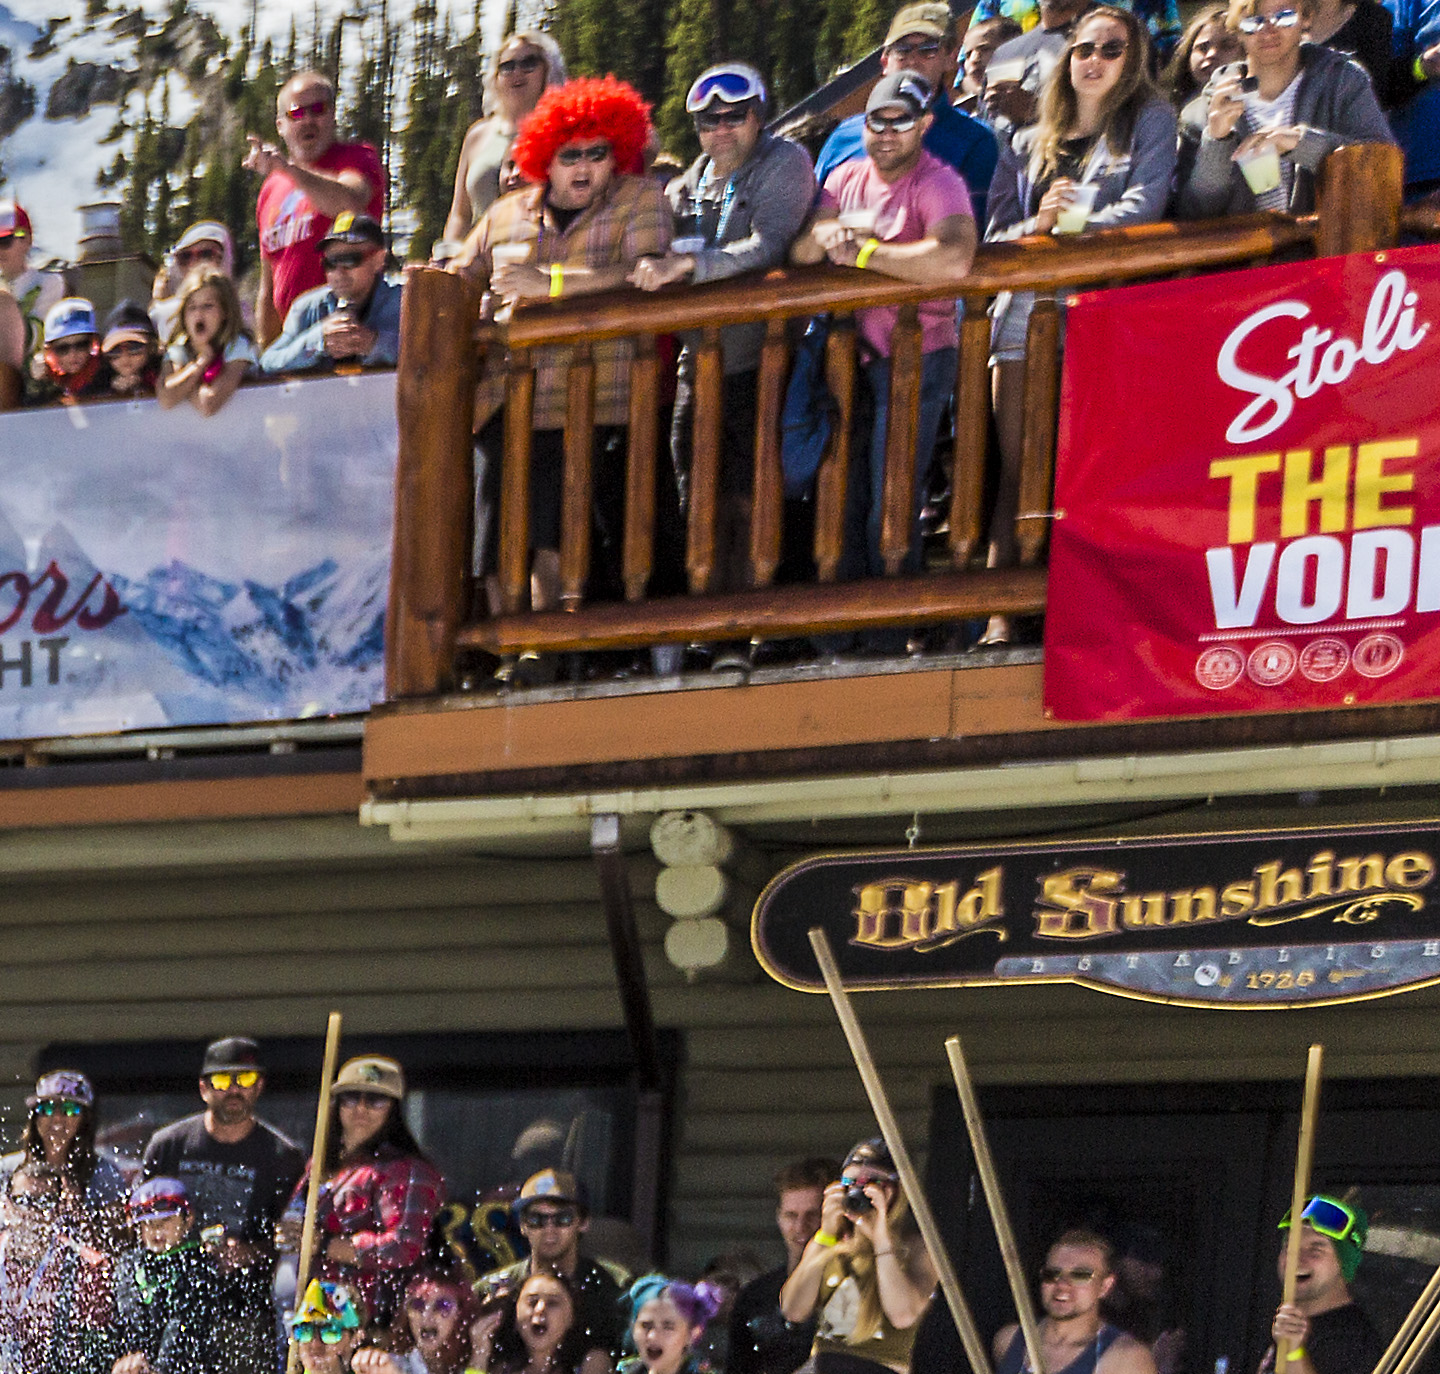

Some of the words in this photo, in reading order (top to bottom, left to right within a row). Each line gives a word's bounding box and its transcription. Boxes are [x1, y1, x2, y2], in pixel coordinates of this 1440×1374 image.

[1217, 268, 1430, 442] Stoli
[1209, 438, 1419, 545] THE
[849, 864, 1005, 952] Old
[1032, 850, 1434, 940] Sunshine
